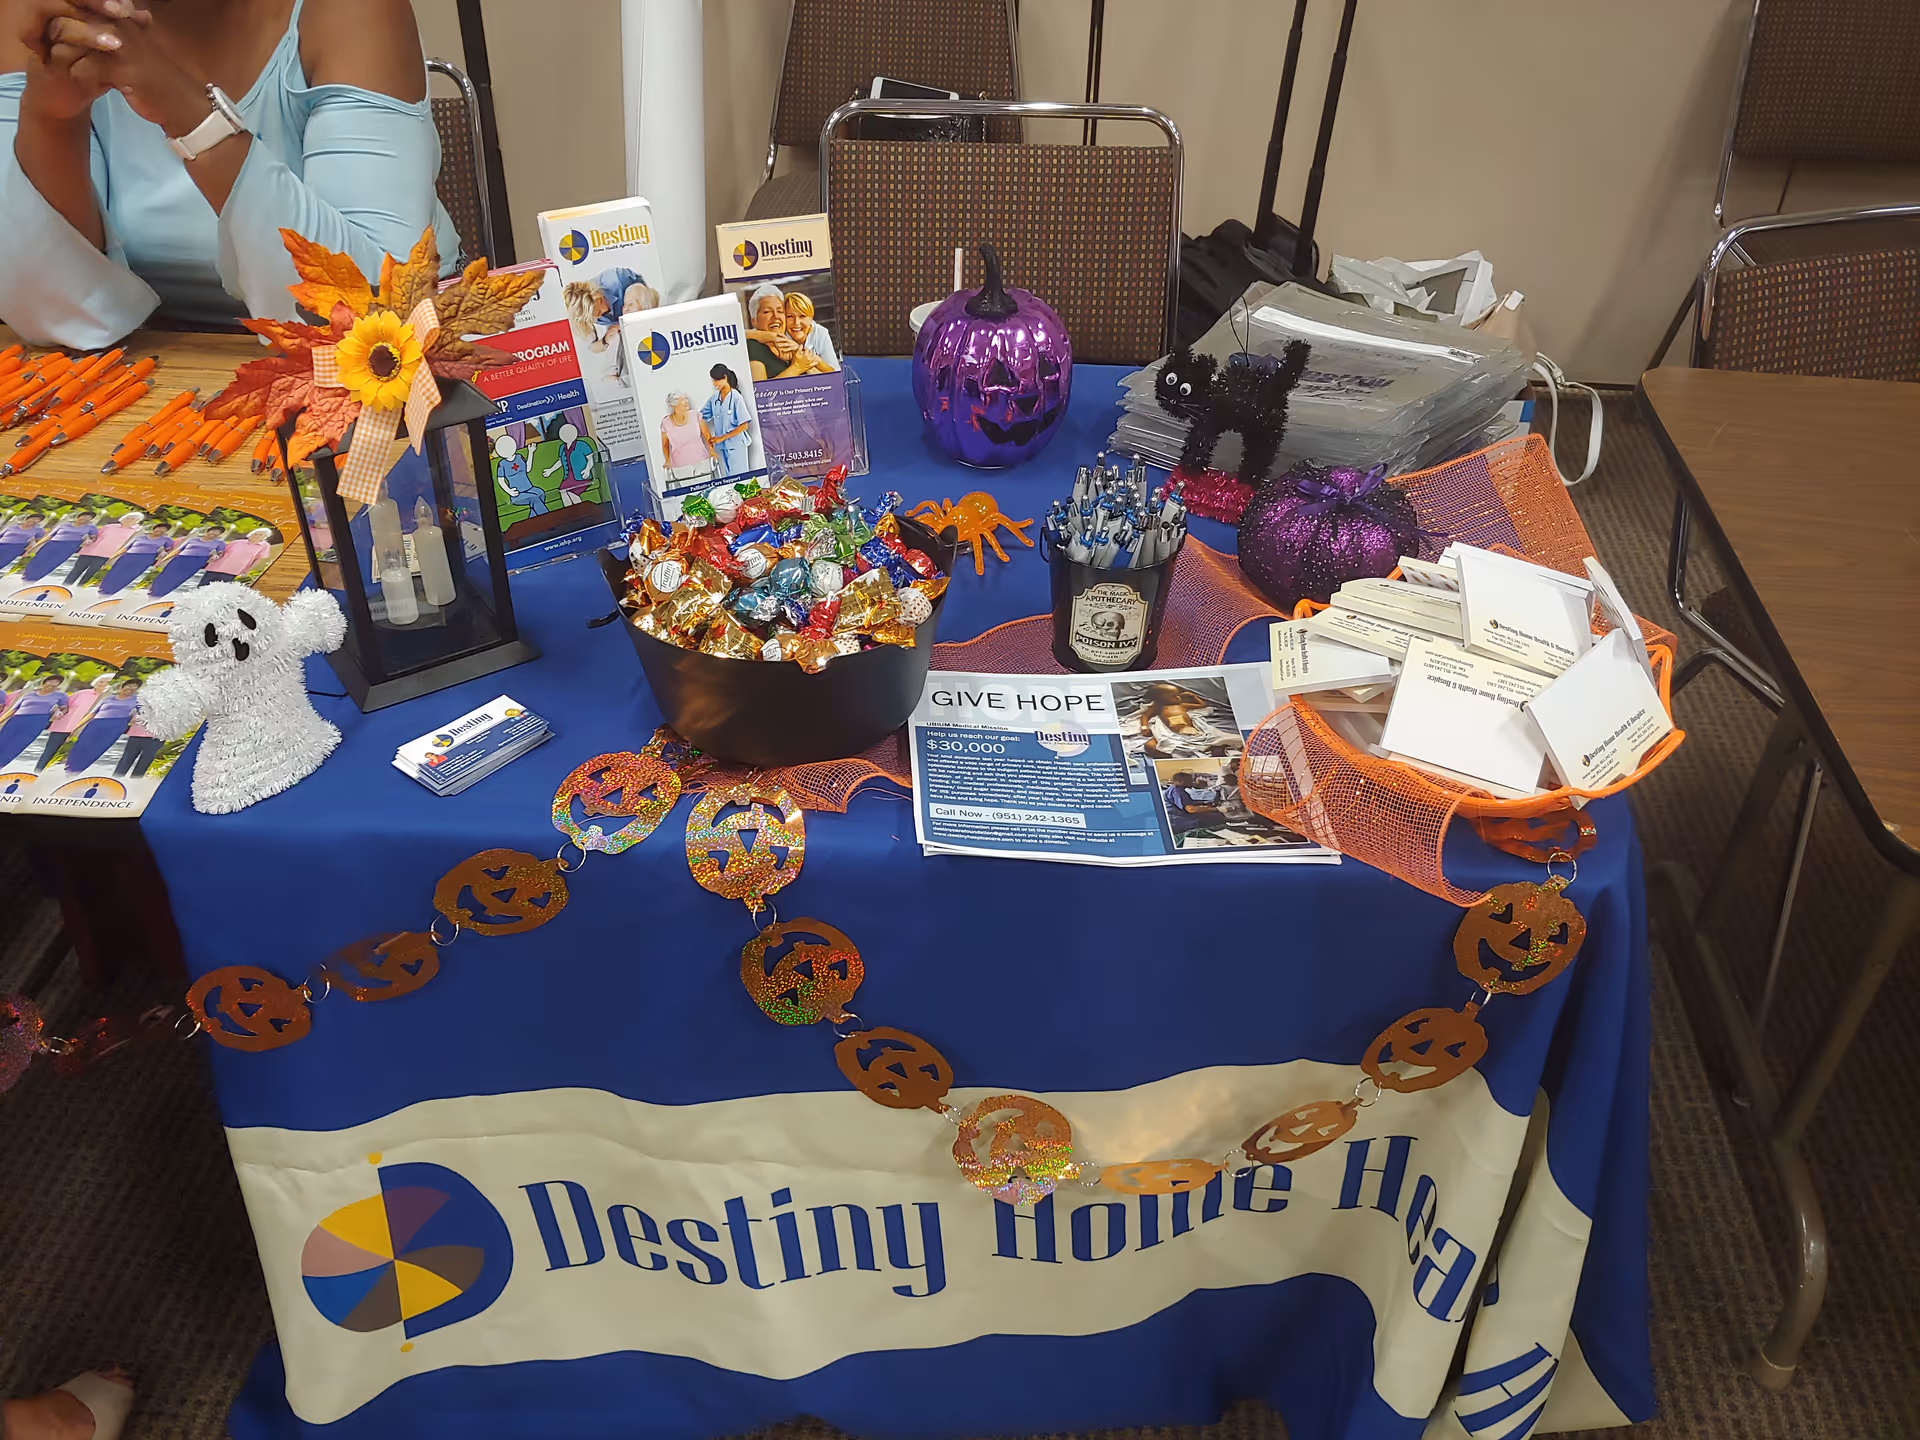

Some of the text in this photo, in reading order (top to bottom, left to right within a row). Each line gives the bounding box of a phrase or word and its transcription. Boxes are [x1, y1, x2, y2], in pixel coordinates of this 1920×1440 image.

[589, 224, 650, 249] Destiny
[760, 238, 812, 257] Destiny
[671, 323, 738, 350] Destiny
[491, 369, 514, 380] BETTER
[516, 363, 545, 373] QUALITY
[560, 355, 572, 363] LIFE
[517, 397, 547, 410] Destination
[558, 390, 579, 400] Health
[1086, 596, 1139, 605] APOTHECARY
[1076, 635, 1115, 647] POISON
[1427, 674, 1451, 687] Hospice
[1458, 684, 1477, 695] Health
[1479, 690, 1495, 701] Home
[932, 691, 1105, 711] GIVE HOPE
[1497, 694, 1519, 708] Destiny
[448, 714, 493, 736] Destiny
[1603, 735, 1616, 747] Home
[1614, 724, 1628, 737] Health
[1630, 708, 1646, 724] Hospice
[927, 739, 1005, 754] $30,000
[32, 797, 134, 808] INDEPENDENCE
[992, 812, 1021, 821] (951)
[1025, 814, 1080, 824] 242-1365
[518, 1179, 947, 1298] Destiny
[992, 1163, 1293, 1264] Home
